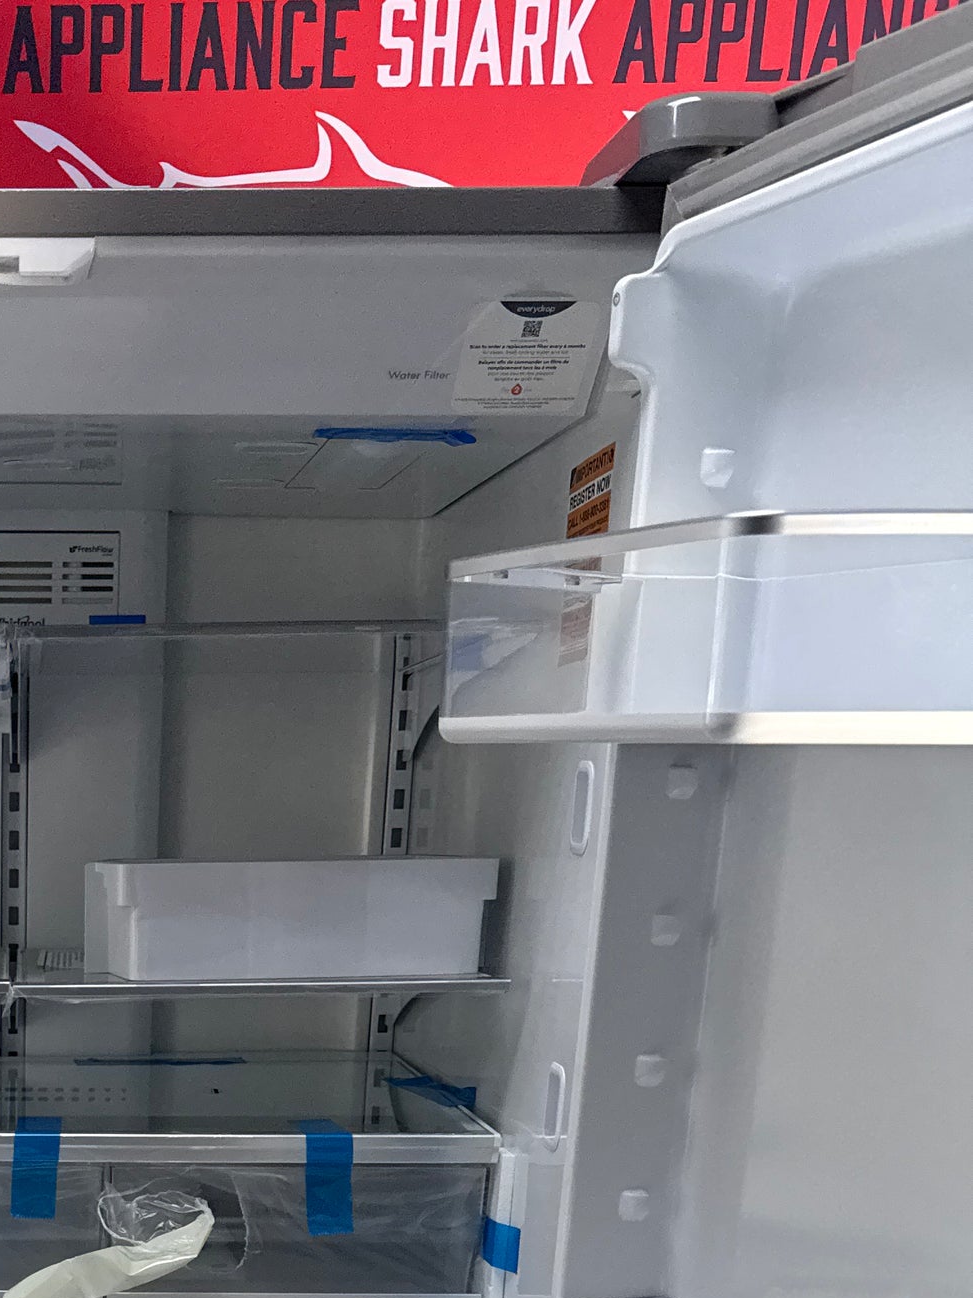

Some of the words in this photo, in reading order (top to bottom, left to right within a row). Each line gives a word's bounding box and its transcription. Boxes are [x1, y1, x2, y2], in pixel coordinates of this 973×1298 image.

[3, 0, 356, 94] APPLIANCE
[376, 0, 593, 88] SHARK
[516, 304, 556, 314] everydrop
[388, 370, 421, 380] Water
[424, 370, 451, 380] Filter
